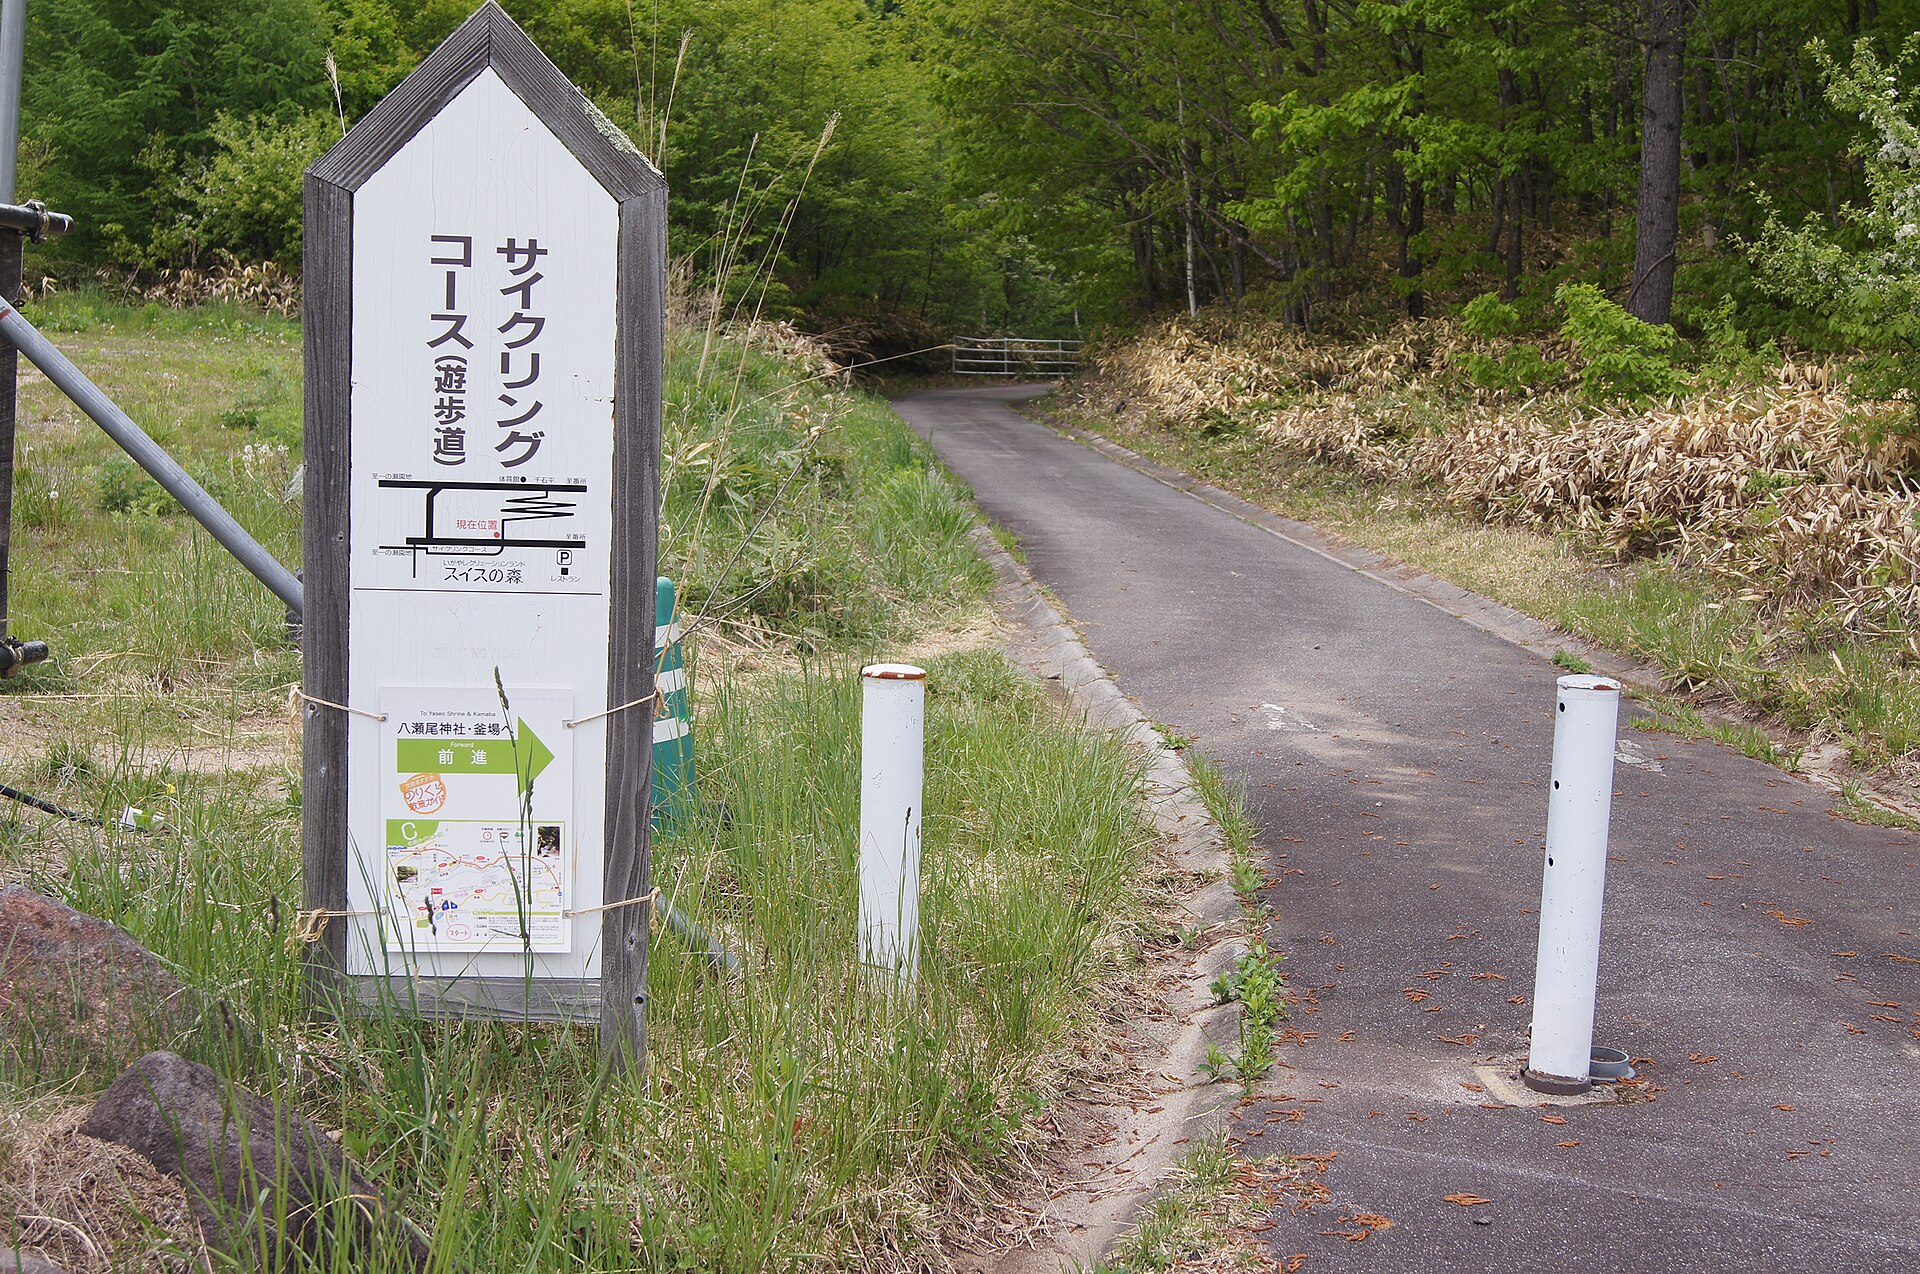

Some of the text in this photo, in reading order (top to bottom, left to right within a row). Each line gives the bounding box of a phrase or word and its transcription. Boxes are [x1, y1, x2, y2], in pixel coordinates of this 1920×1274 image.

[494, 237, 548, 468] サイクリング
[456, 519, 498, 530] 現在位置
[560, 551, 570, 564] P
[444, 567, 524, 584] スイスの森
[404, 782, 444, 802] のりくら
[402, 822, 418, 841] C
